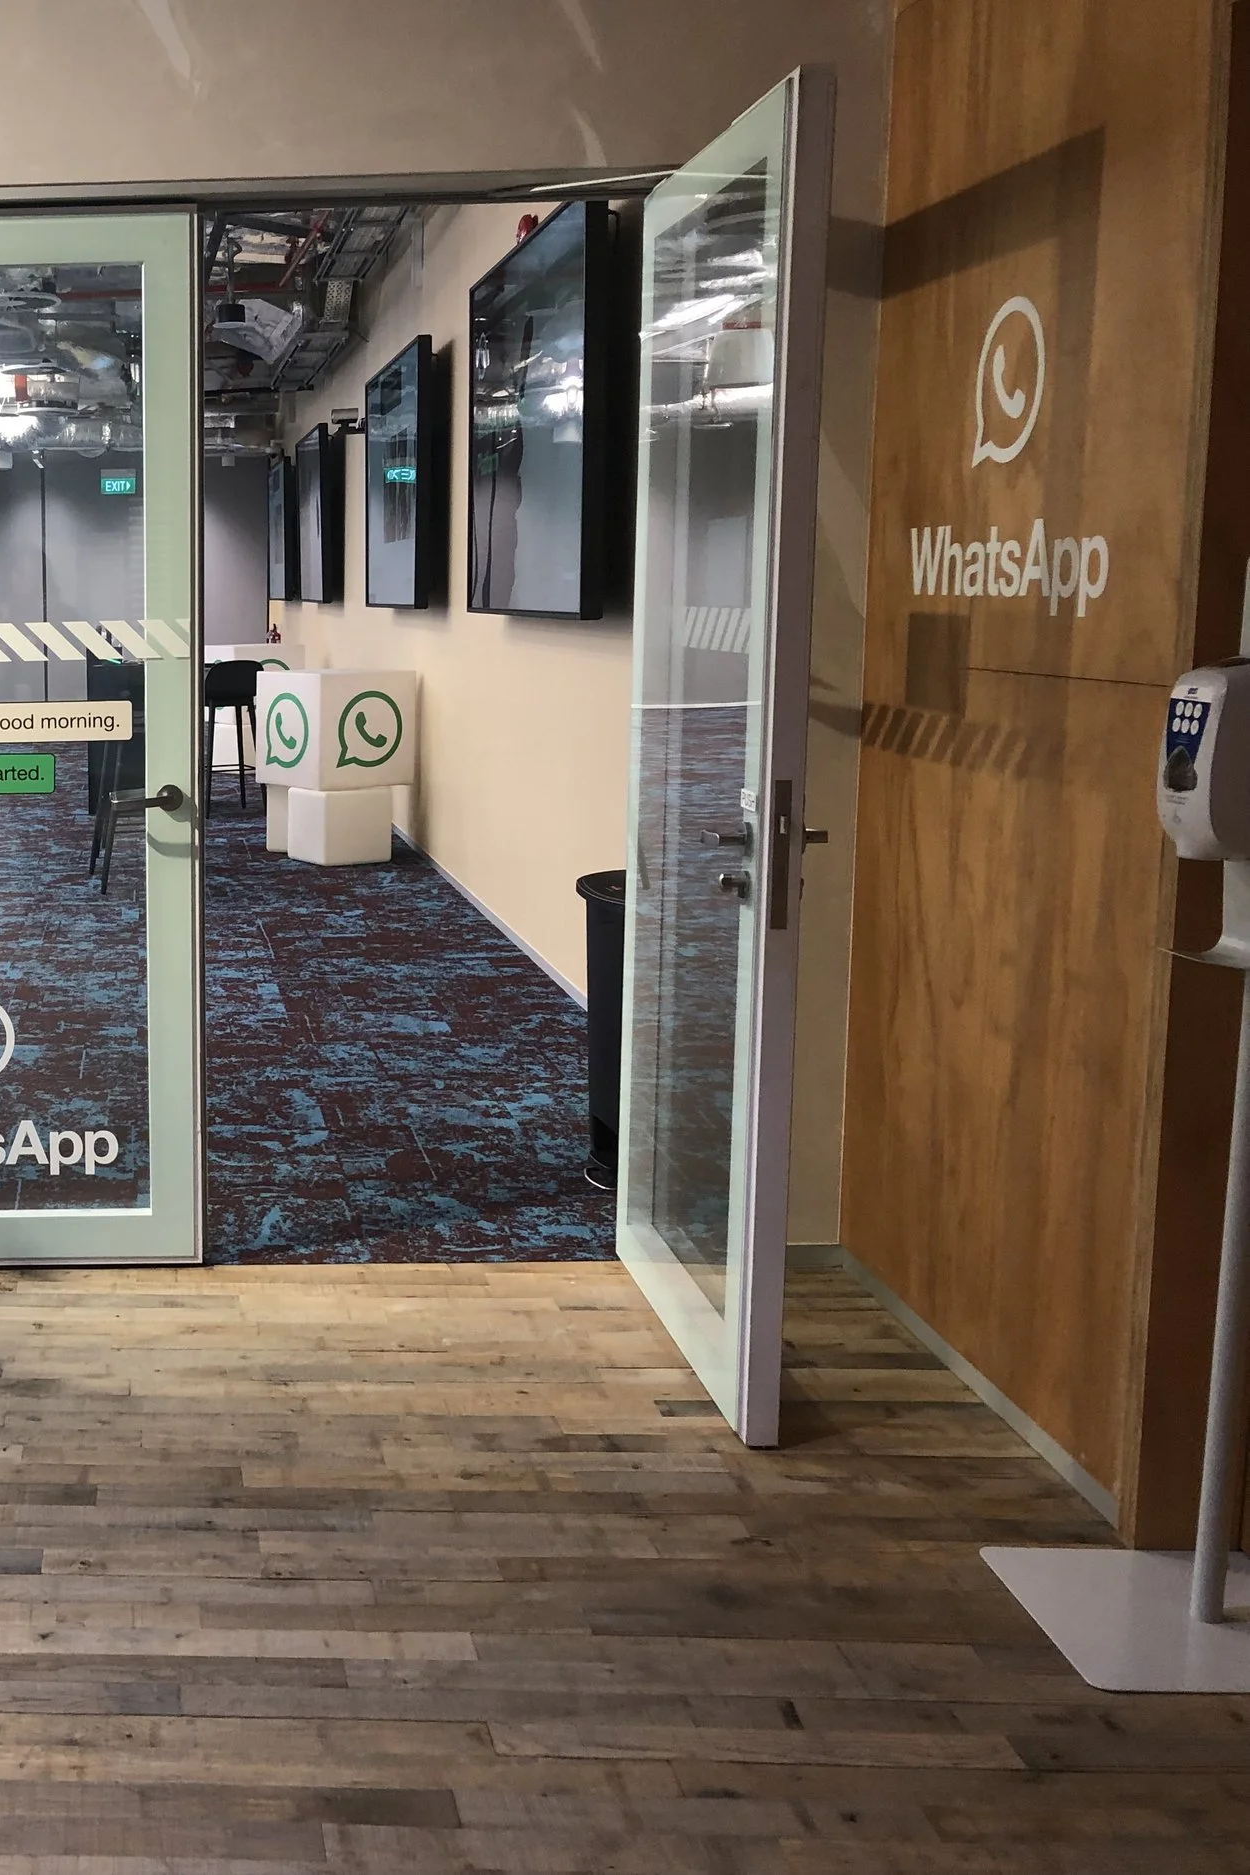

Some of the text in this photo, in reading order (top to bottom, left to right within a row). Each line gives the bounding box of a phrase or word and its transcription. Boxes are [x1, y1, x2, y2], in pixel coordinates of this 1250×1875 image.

[105, 480, 126, 492] EXIT
[910, 518, 1109, 617] WhatsApp
[40, 712, 120, 734] morning.
